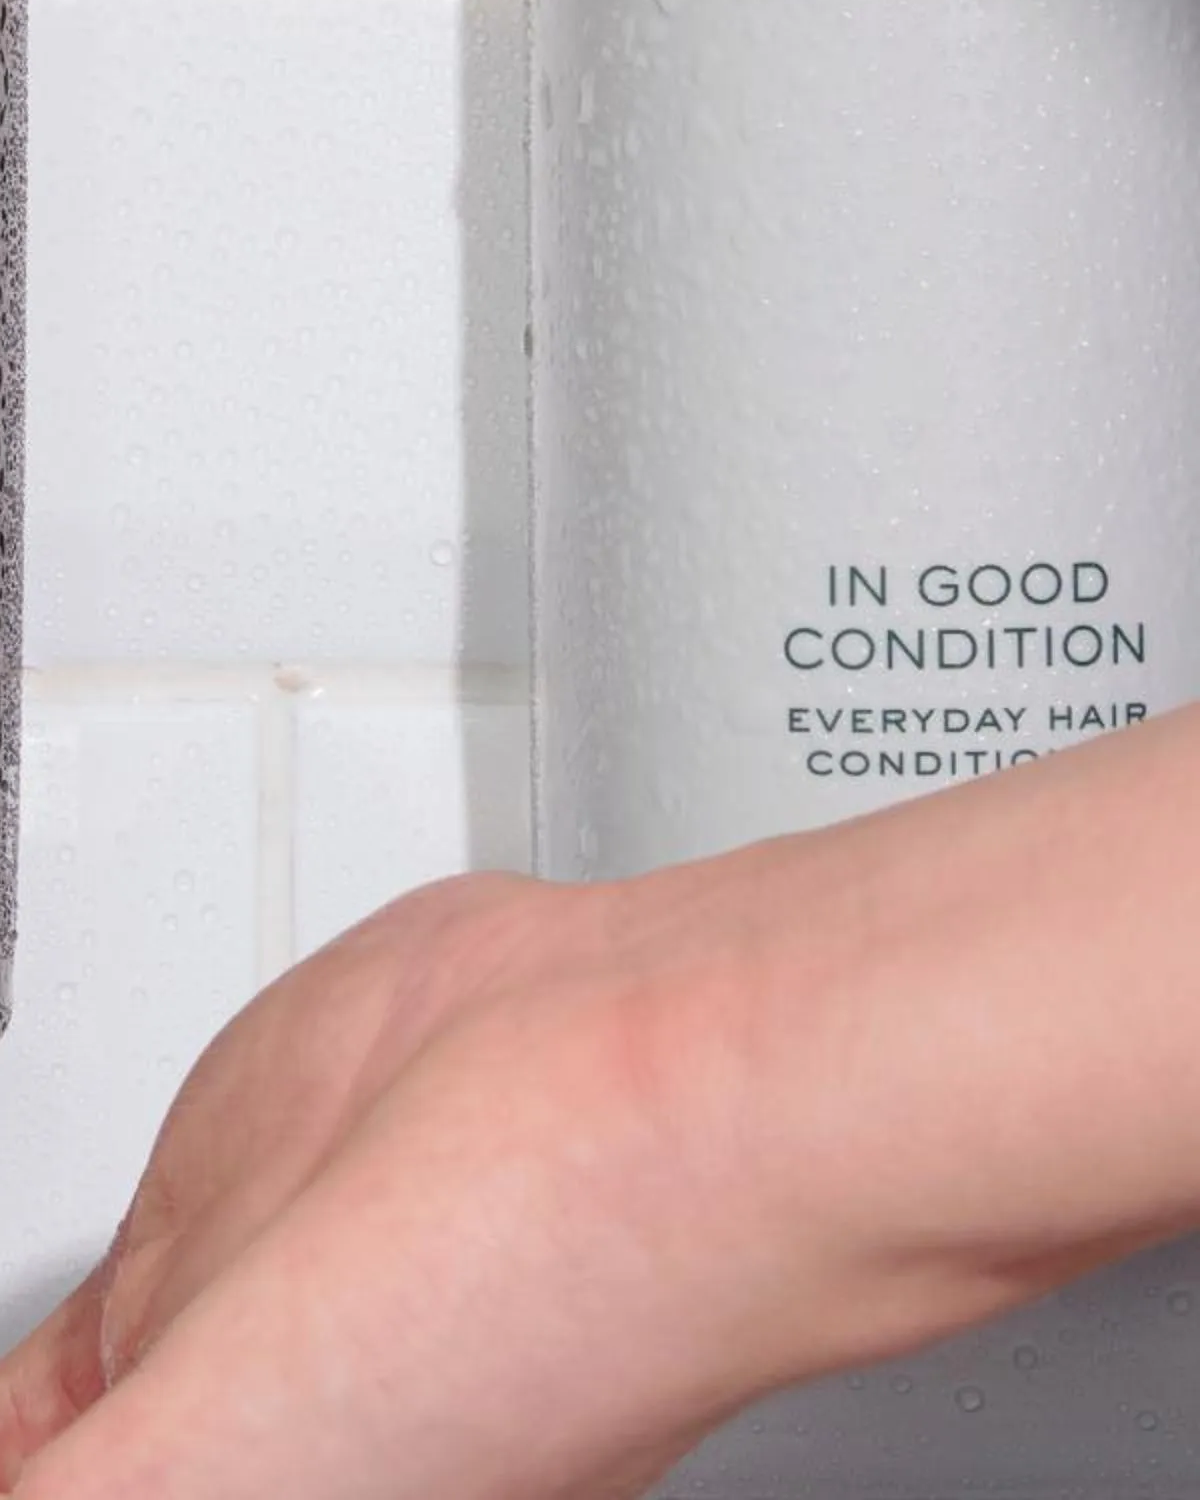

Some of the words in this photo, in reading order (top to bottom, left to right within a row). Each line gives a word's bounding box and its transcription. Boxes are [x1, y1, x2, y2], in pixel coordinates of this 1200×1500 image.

[828, 565, 887, 607] IN
[918, 562, 1108, 607] GOOD
[784, 622, 1146, 670] CONDITION
[787, 706, 1028, 734] EVERYDAY
[1049, 702, 1147, 731] HAIR
[806, 748, 1056, 777] CONDITI
